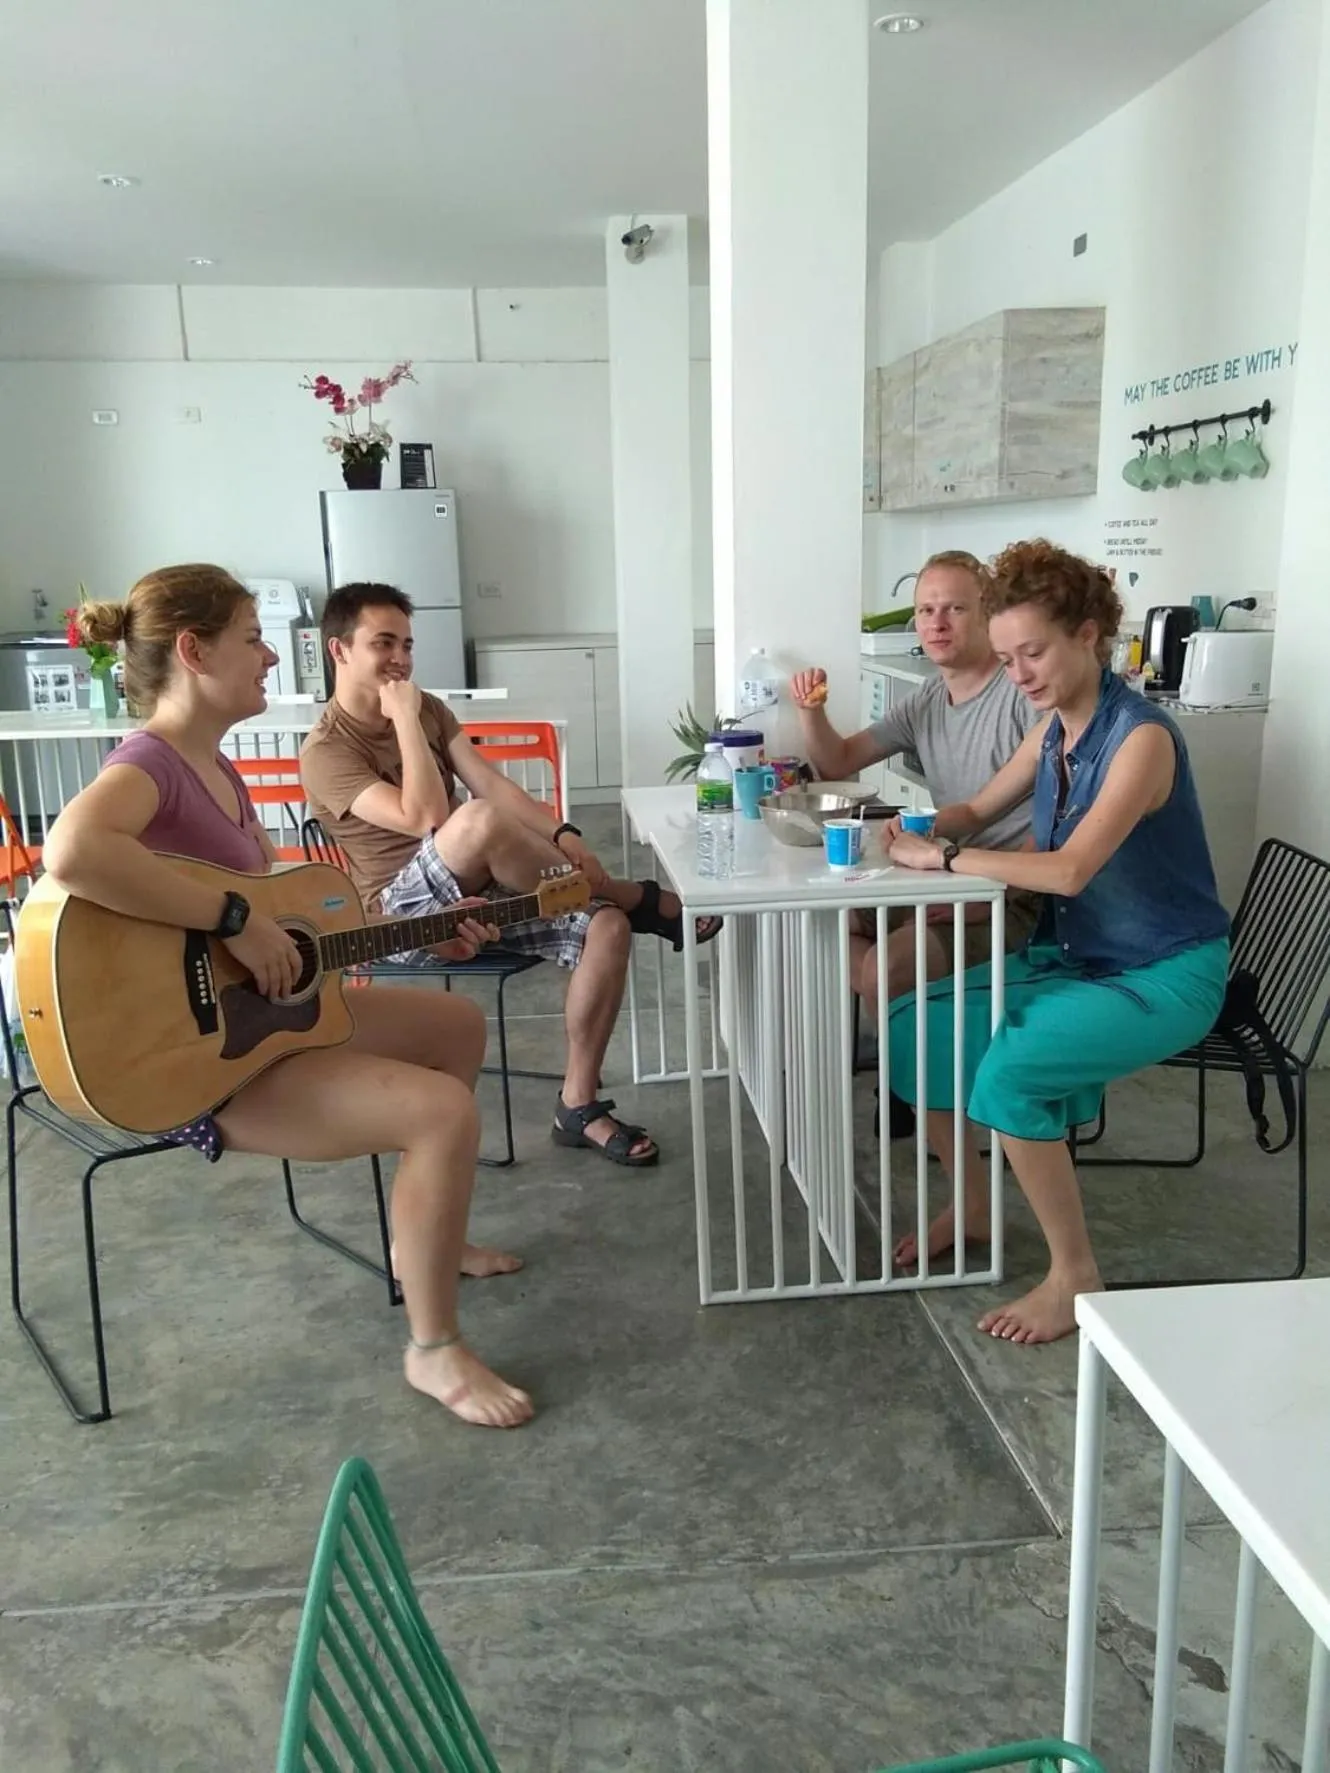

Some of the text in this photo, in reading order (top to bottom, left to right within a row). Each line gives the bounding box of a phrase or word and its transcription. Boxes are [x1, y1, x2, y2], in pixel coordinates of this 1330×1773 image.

[1124, 383, 1147, 406] MAY
[1150, 377, 1170, 398] THE
[1174, 364, 1219, 392] COFFEE
[1224, 358, 1241, 381] BE
[1246, 347, 1282, 375] WITH
